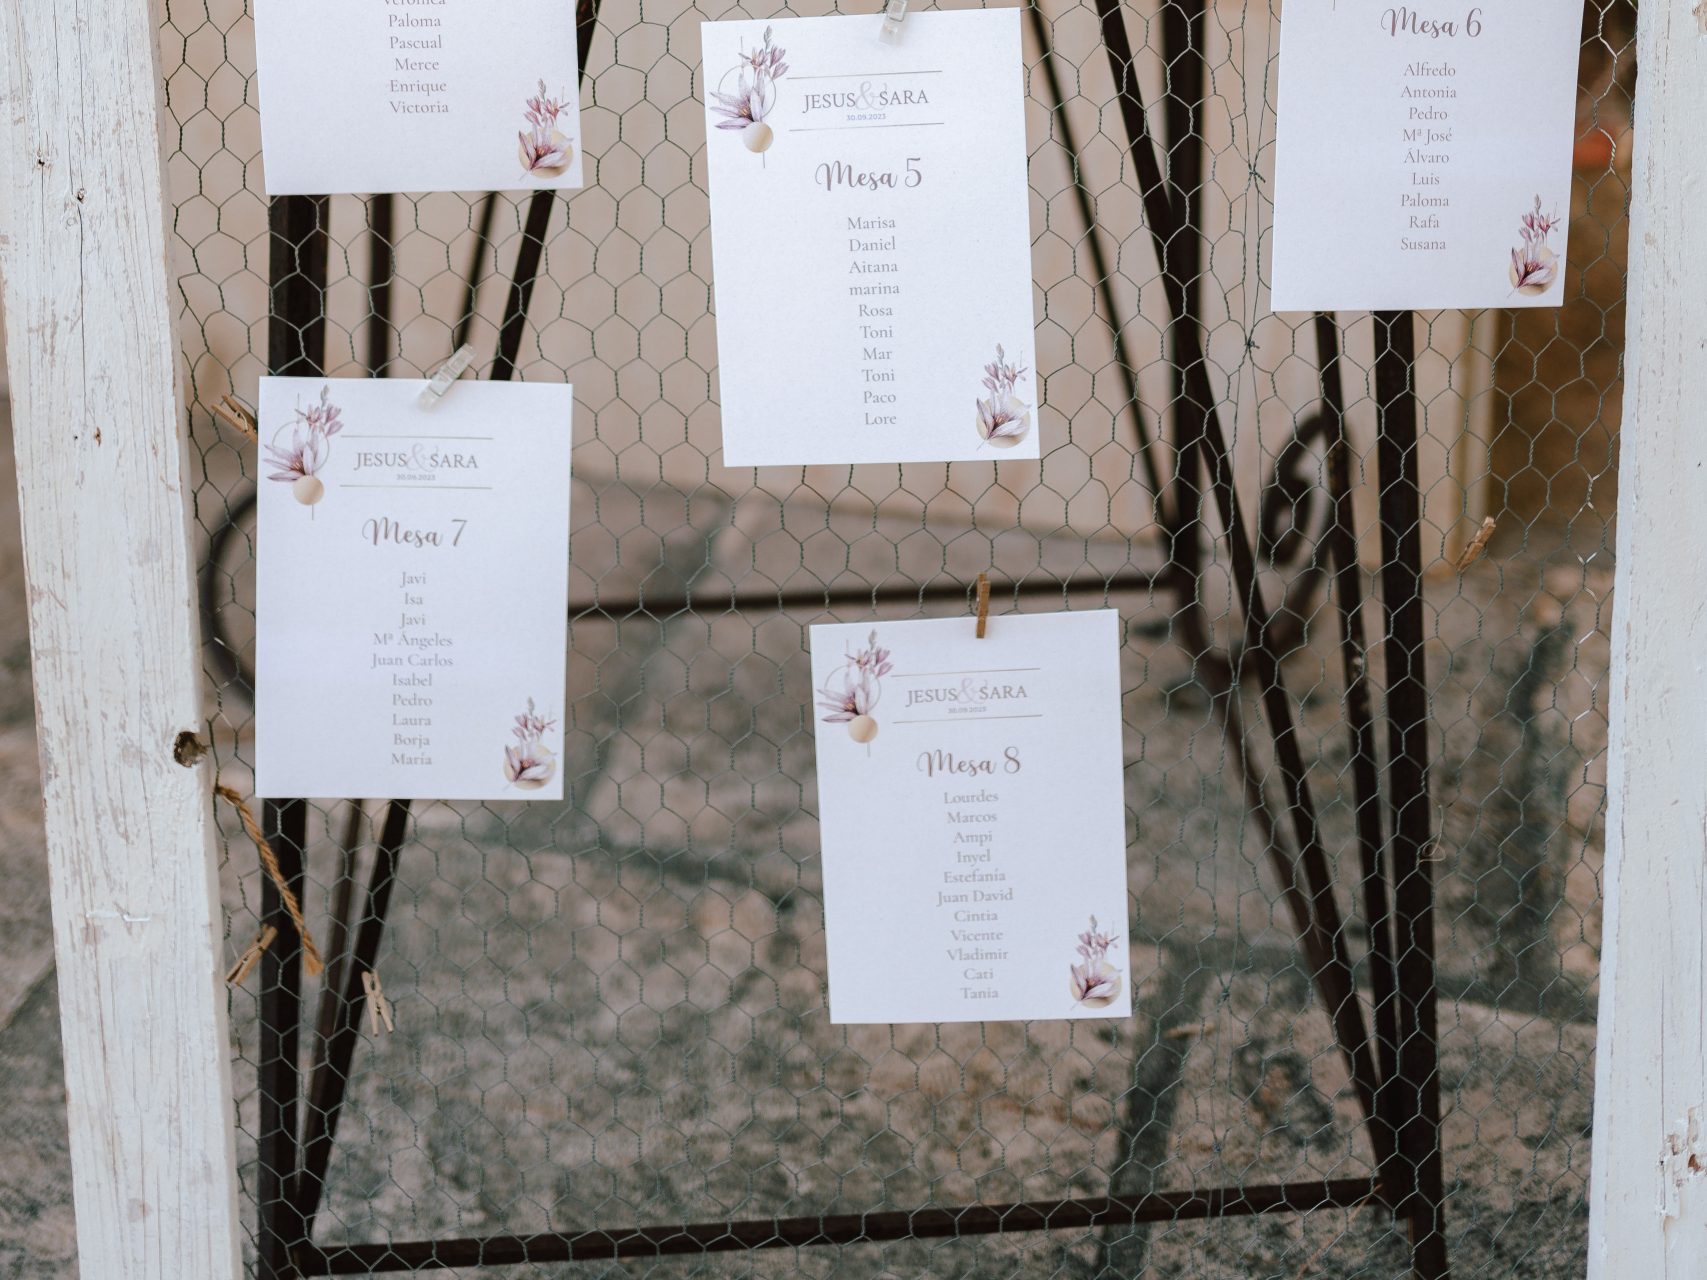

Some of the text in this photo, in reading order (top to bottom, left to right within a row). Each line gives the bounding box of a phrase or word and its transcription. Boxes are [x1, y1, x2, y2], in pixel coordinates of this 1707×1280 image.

[388, 12, 441, 27] Paloma
[1380, 7, 1483, 39] Mesa 6
[390, 34, 442, 49] Pascual
[395, 57, 439, 71] Merce
[1404, 61, 1456, 76] Alfredo
[390, 79, 447, 97] Enrique
[1401, 85, 1456, 98] Antonia
[389, 101, 449, 114] Victoria
[1409, 105, 1448, 120] Pedro
[846, 112, 887, 121] 30.09.2023
[1424, 127, 1452, 145] José
[1404, 148, 1449, 163] Álvaro
[814, 156, 923, 192] Mesa 5
[1413, 172, 1440, 185] Luis
[1401, 192, 1449, 207] Paloma
[848, 216, 896, 230] Marisa
[1410, 214, 1439, 228] Rafa
[849, 235, 896, 252] Daniel
[1401, 237, 1446, 250] Susana
[849, 261, 898, 274] Aitana
[849, 282, 900, 296] marina
[859, 304, 893, 317] Rosa
[859, 325, 893, 339] Toni
[863, 347, 892, 360] Mar
[861, 369, 895, 382] Toni
[864, 391, 896, 404] Paco
[865, 412, 897, 425] Lore
[361, 516, 468, 549] Mesa 7
[400, 571, 426, 588] Javi
[405, 592, 423, 605] Isa
[399, 613, 425, 629] Javi
[371, 653, 454, 670] Juan Carlos
[392, 672, 432, 686] Isabel
[393, 692, 433, 706] Pedro
[393, 713, 431, 726] Laura
[394, 733, 430, 749] Borja
[916, 745, 1021, 778] Mesa 8
[944, 789, 999, 804] Lourdes
[948, 811, 997, 823] Marcos
[936, 888, 1013, 907] Juan David
[950, 930, 1003, 941] Vicente
[947, 948, 1008, 961] Vladimir
[964, 969, 993, 980] Cati
[960, 987, 998, 999] Tania
